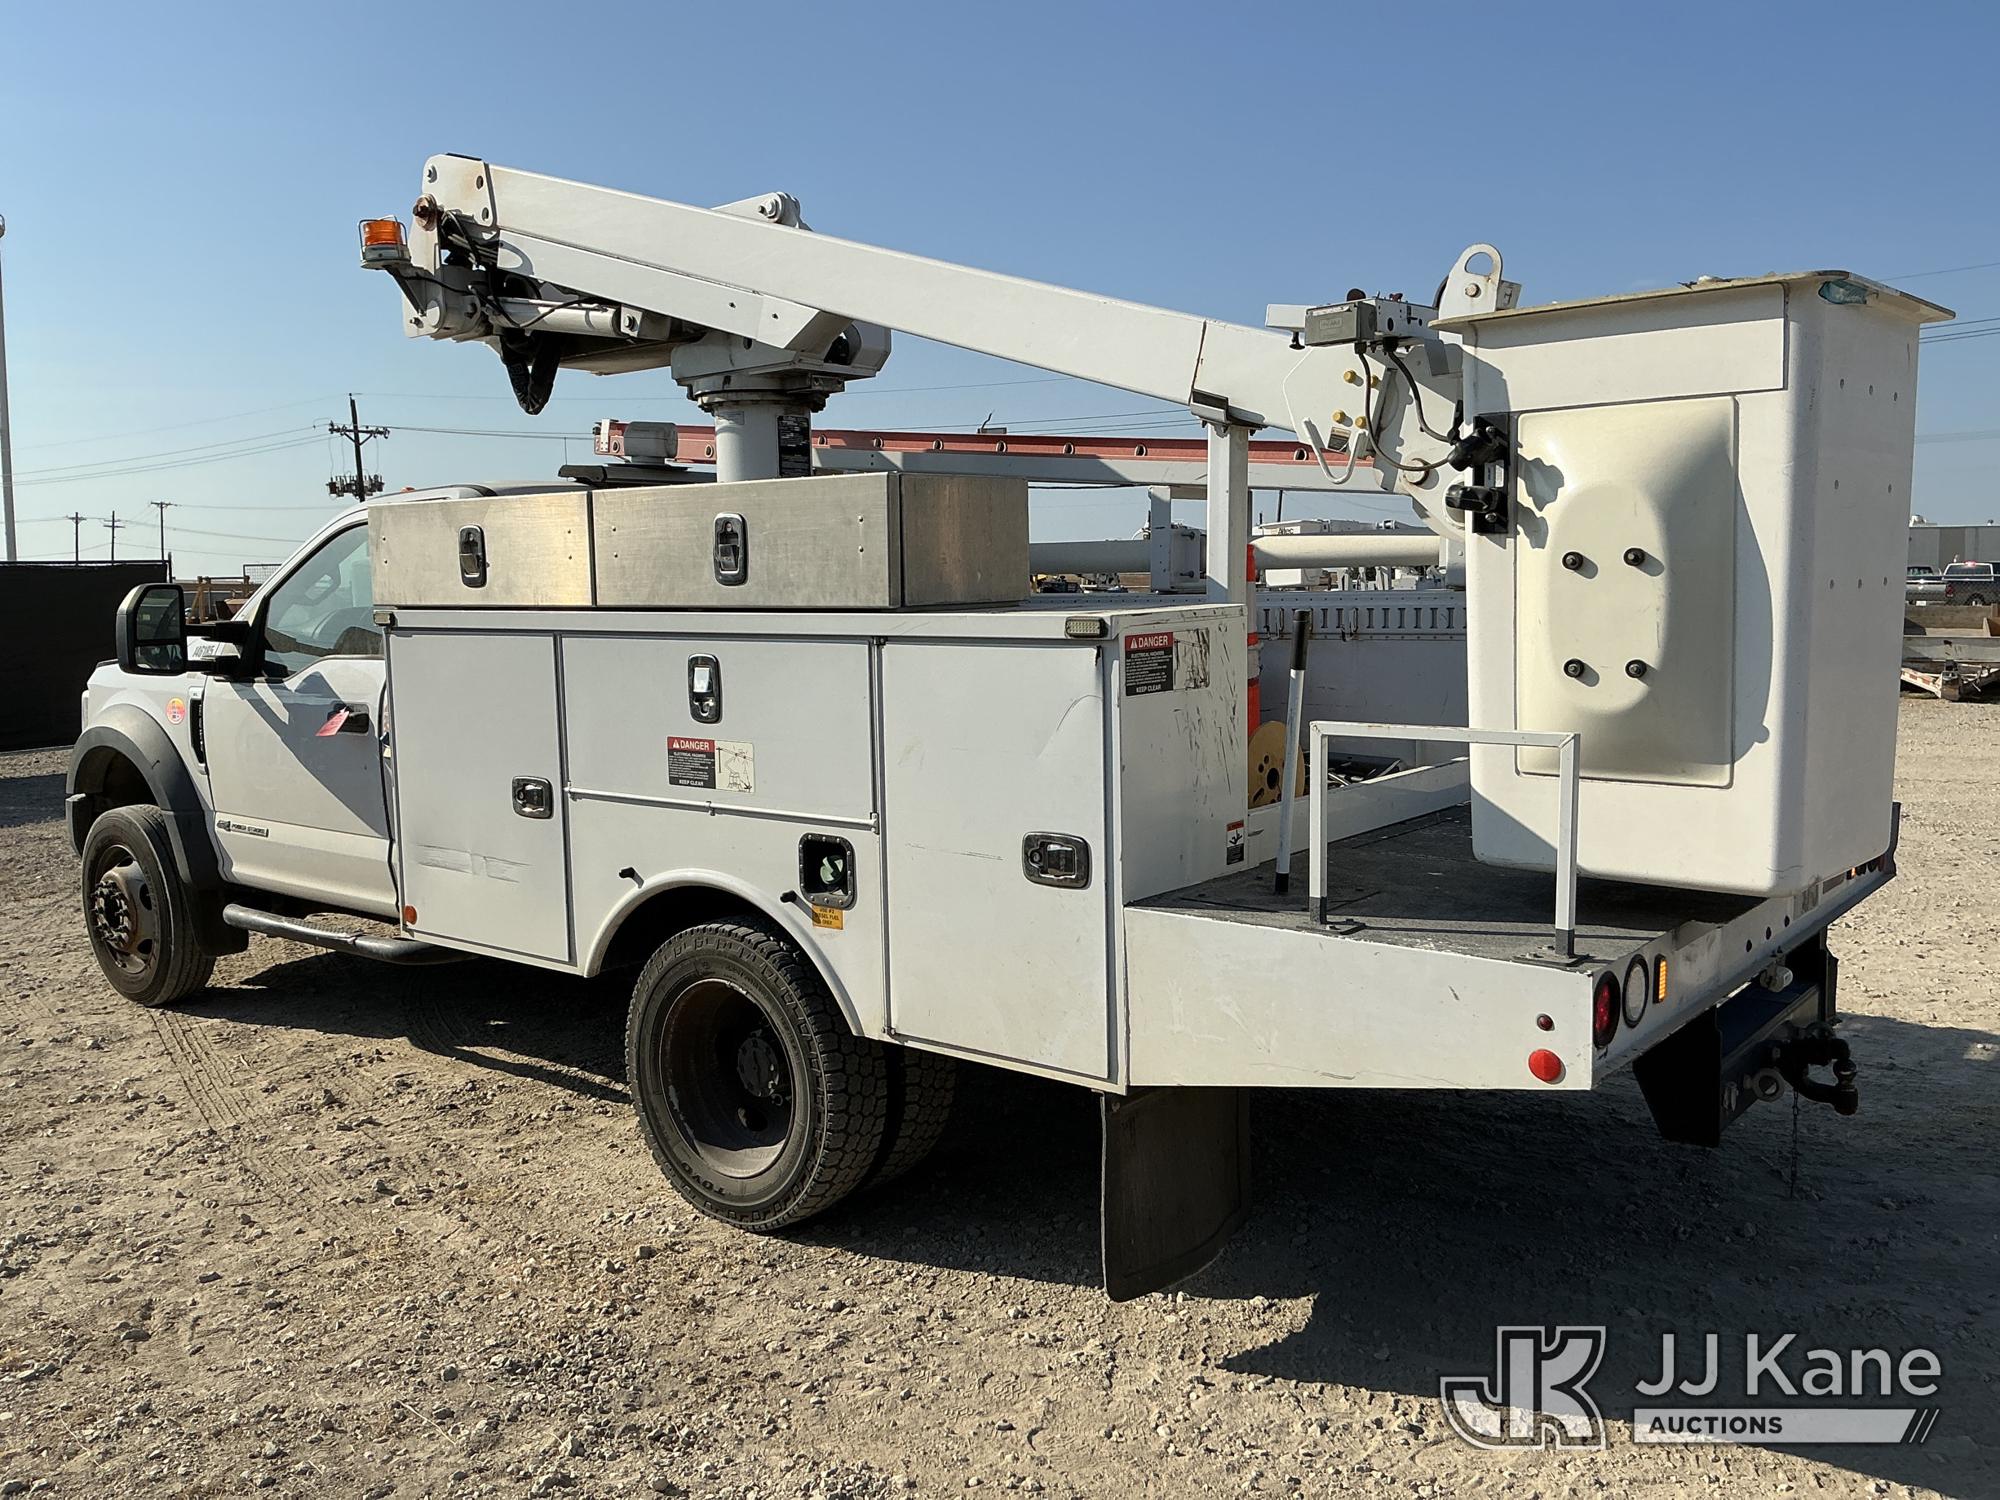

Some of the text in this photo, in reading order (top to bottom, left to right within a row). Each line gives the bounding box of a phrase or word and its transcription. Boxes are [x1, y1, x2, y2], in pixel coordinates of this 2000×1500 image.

[1138, 635, 1168, 648] DANGER
[1147, 684, 1162, 692] CLEAR
[680, 740, 710, 751] DANGER
[681, 1162, 726, 1196] TOYO
